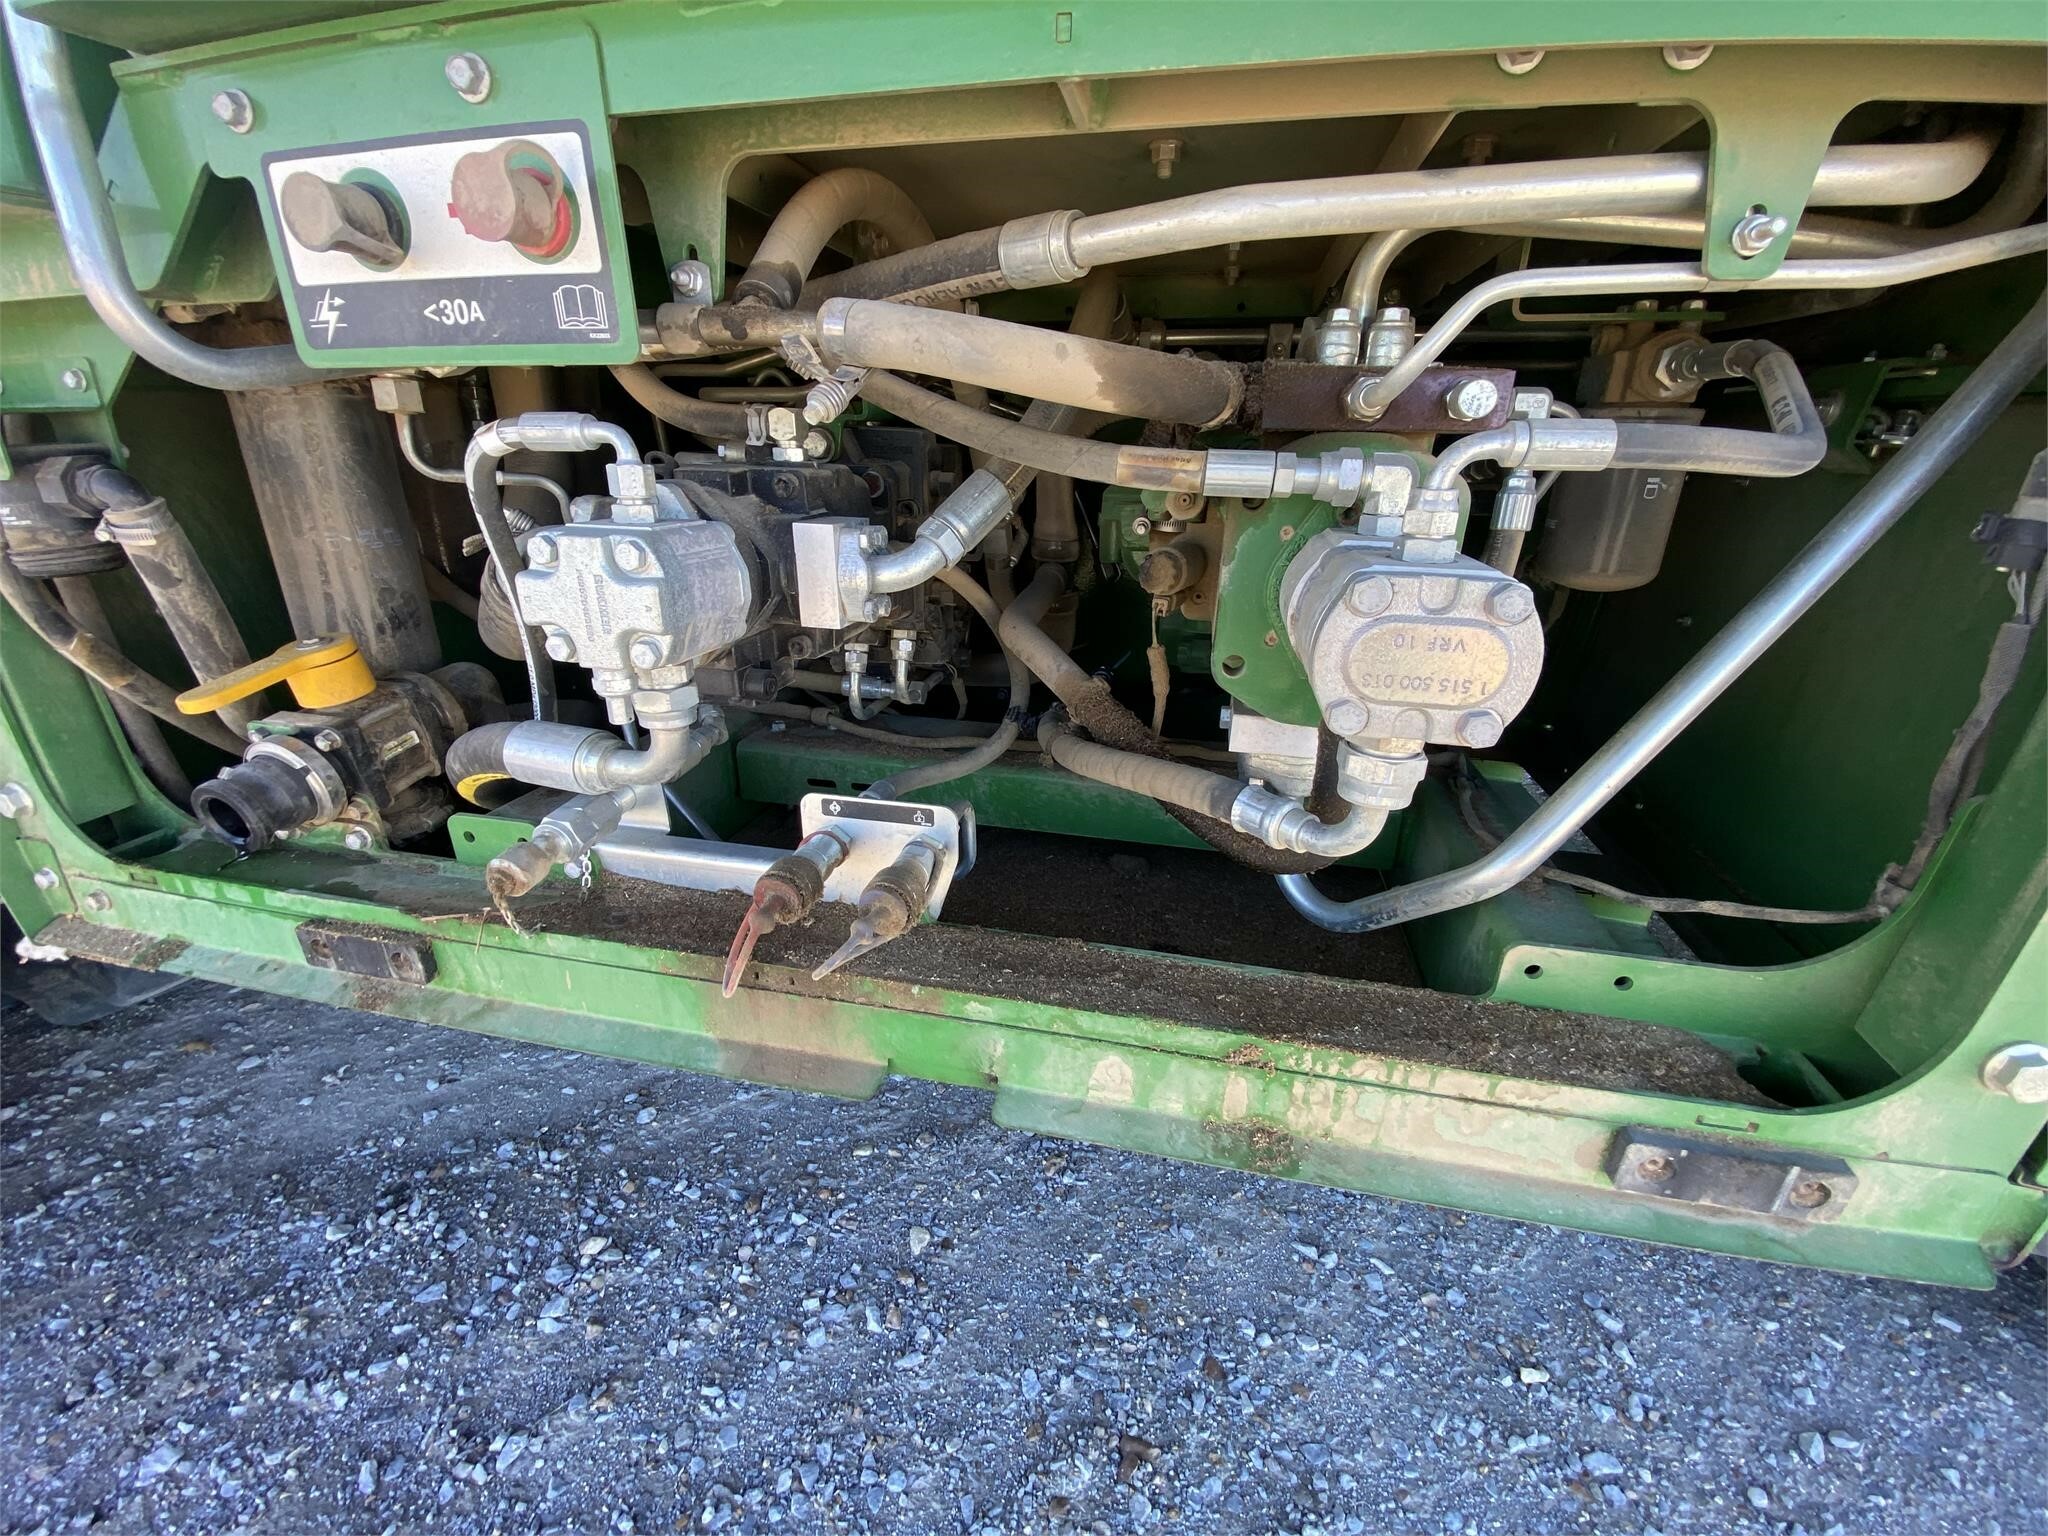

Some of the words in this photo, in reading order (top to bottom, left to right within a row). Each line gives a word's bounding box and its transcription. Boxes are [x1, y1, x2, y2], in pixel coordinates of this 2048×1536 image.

[423, 298, 487, 326] <30A
[1392, 633, 1415, 650] 10
[1425, 636, 1467, 653] VRF
